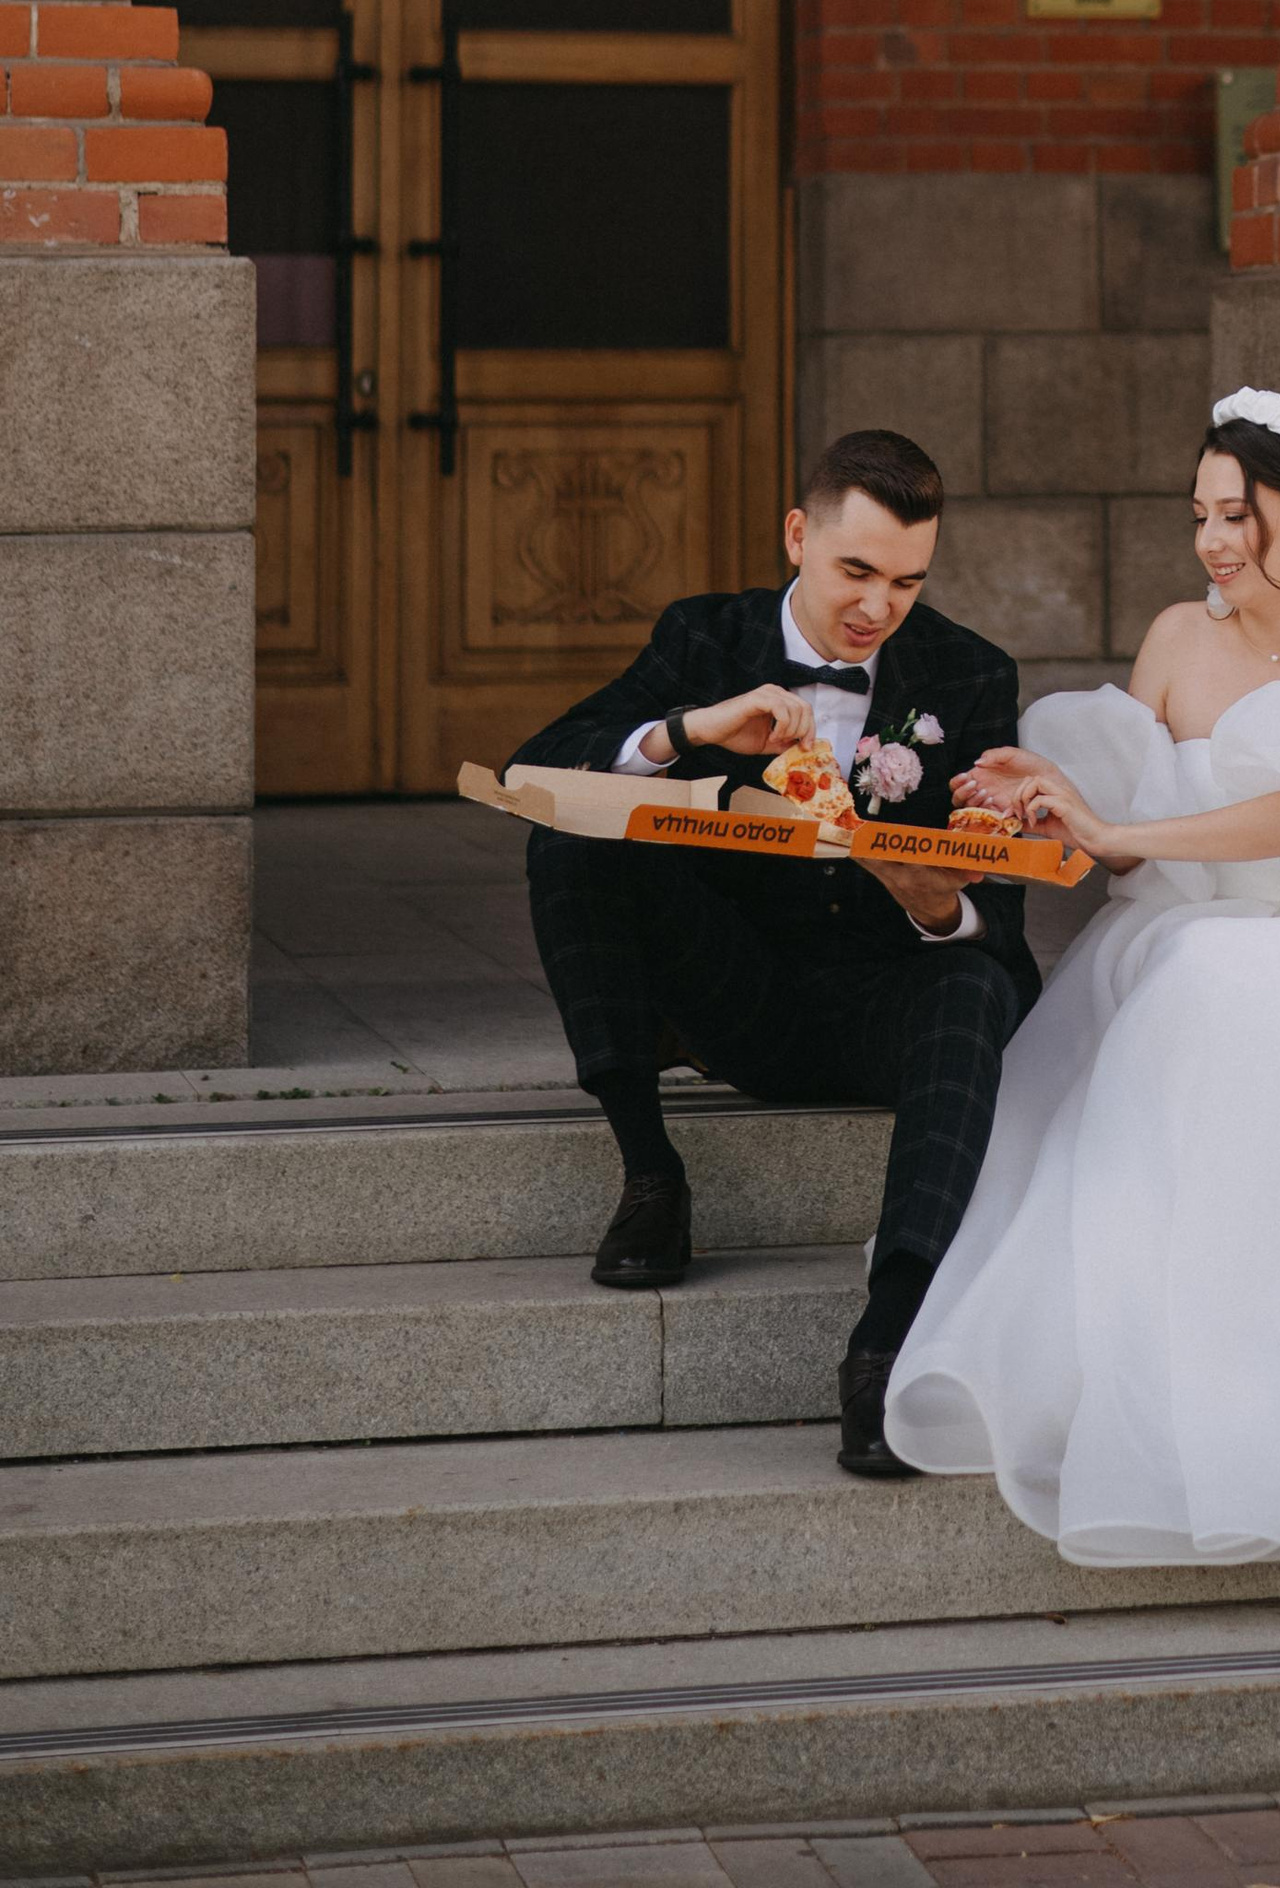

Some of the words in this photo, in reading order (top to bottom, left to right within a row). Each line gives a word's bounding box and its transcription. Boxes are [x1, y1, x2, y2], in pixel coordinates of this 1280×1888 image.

[653, 814, 730, 837] ПИЦЦА
[733, 822, 795, 844] ДОДО
[870, 832, 932, 855] ДОДО
[936, 839, 1010, 863] ПИЦЦА
